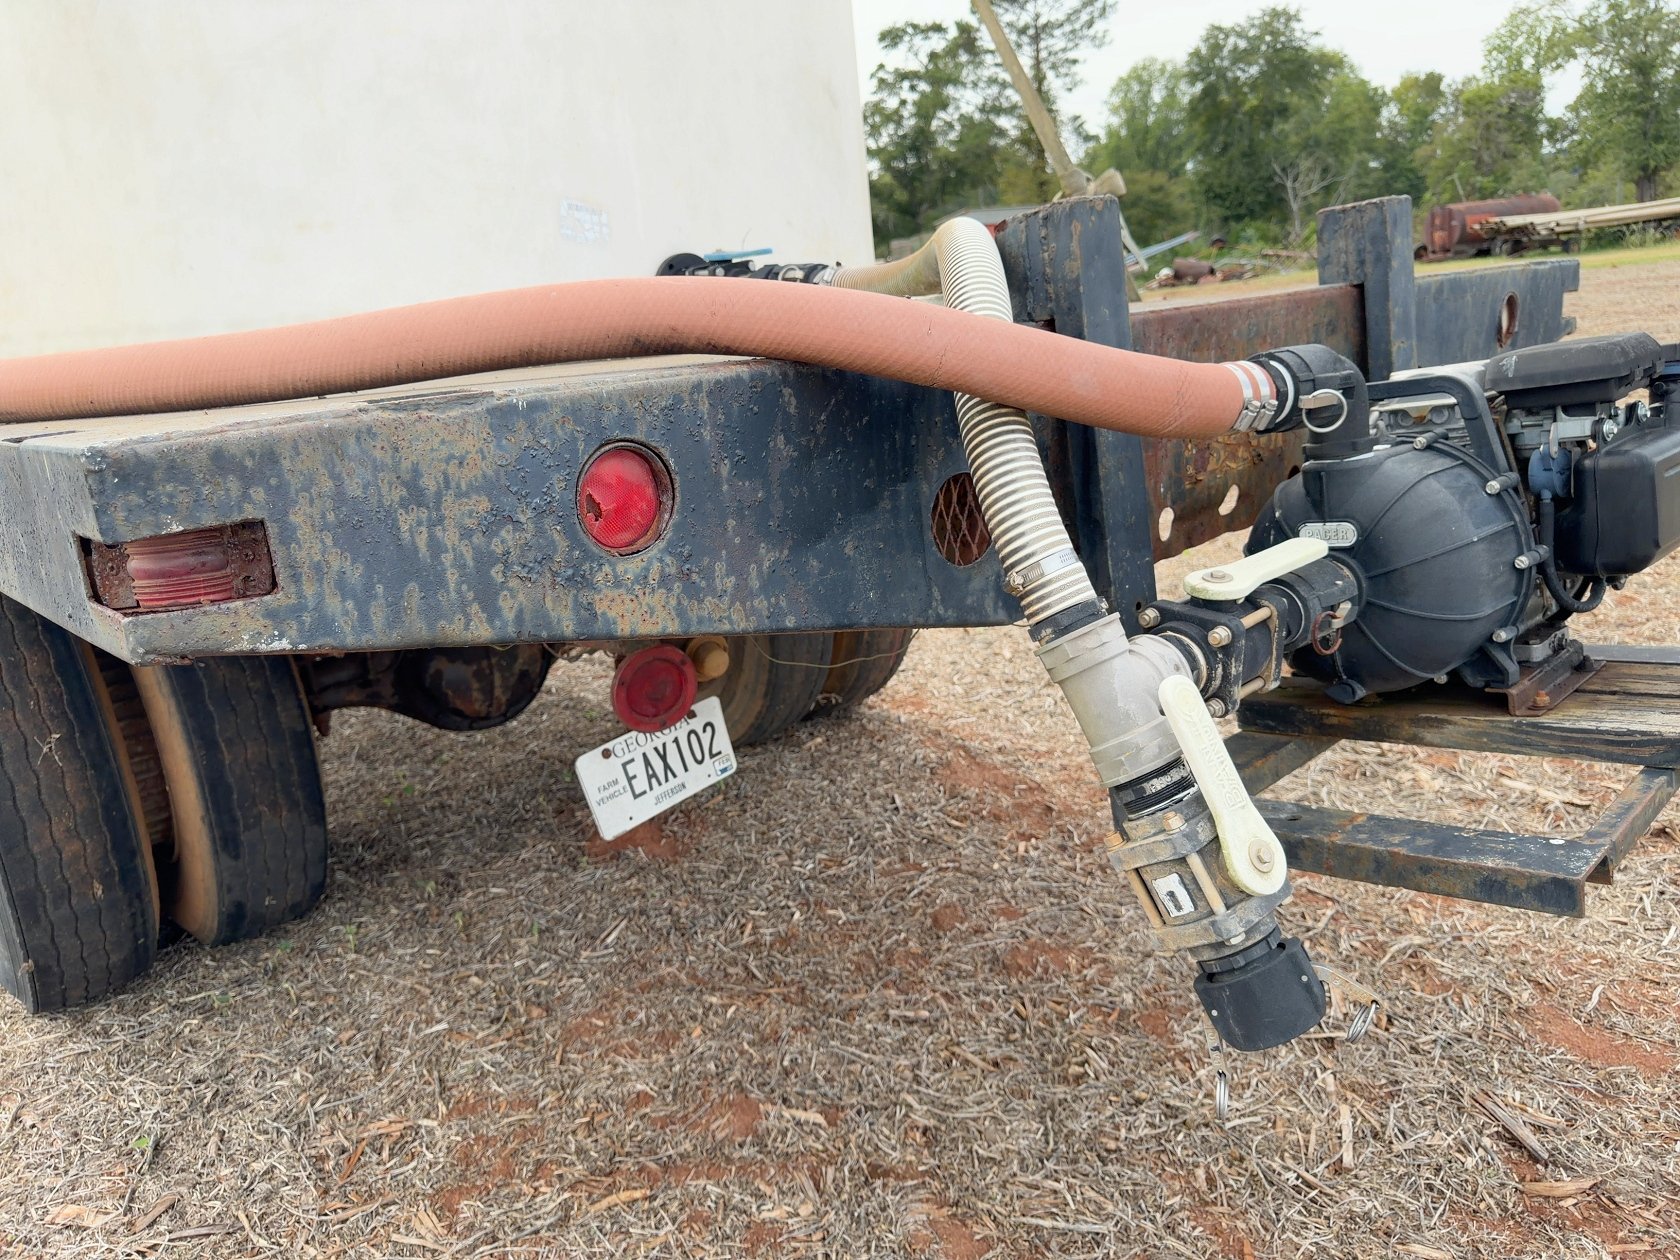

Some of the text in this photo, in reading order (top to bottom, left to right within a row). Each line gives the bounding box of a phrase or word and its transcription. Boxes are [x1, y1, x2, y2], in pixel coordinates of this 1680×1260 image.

[1305, 527, 1348, 540] PACER
[621, 721, 722, 800] EAX102
[595, 785, 629, 807] VEHICLE
[597, 777, 620, 794] FARM
[654, 781, 687, 805] JEFFERSON
